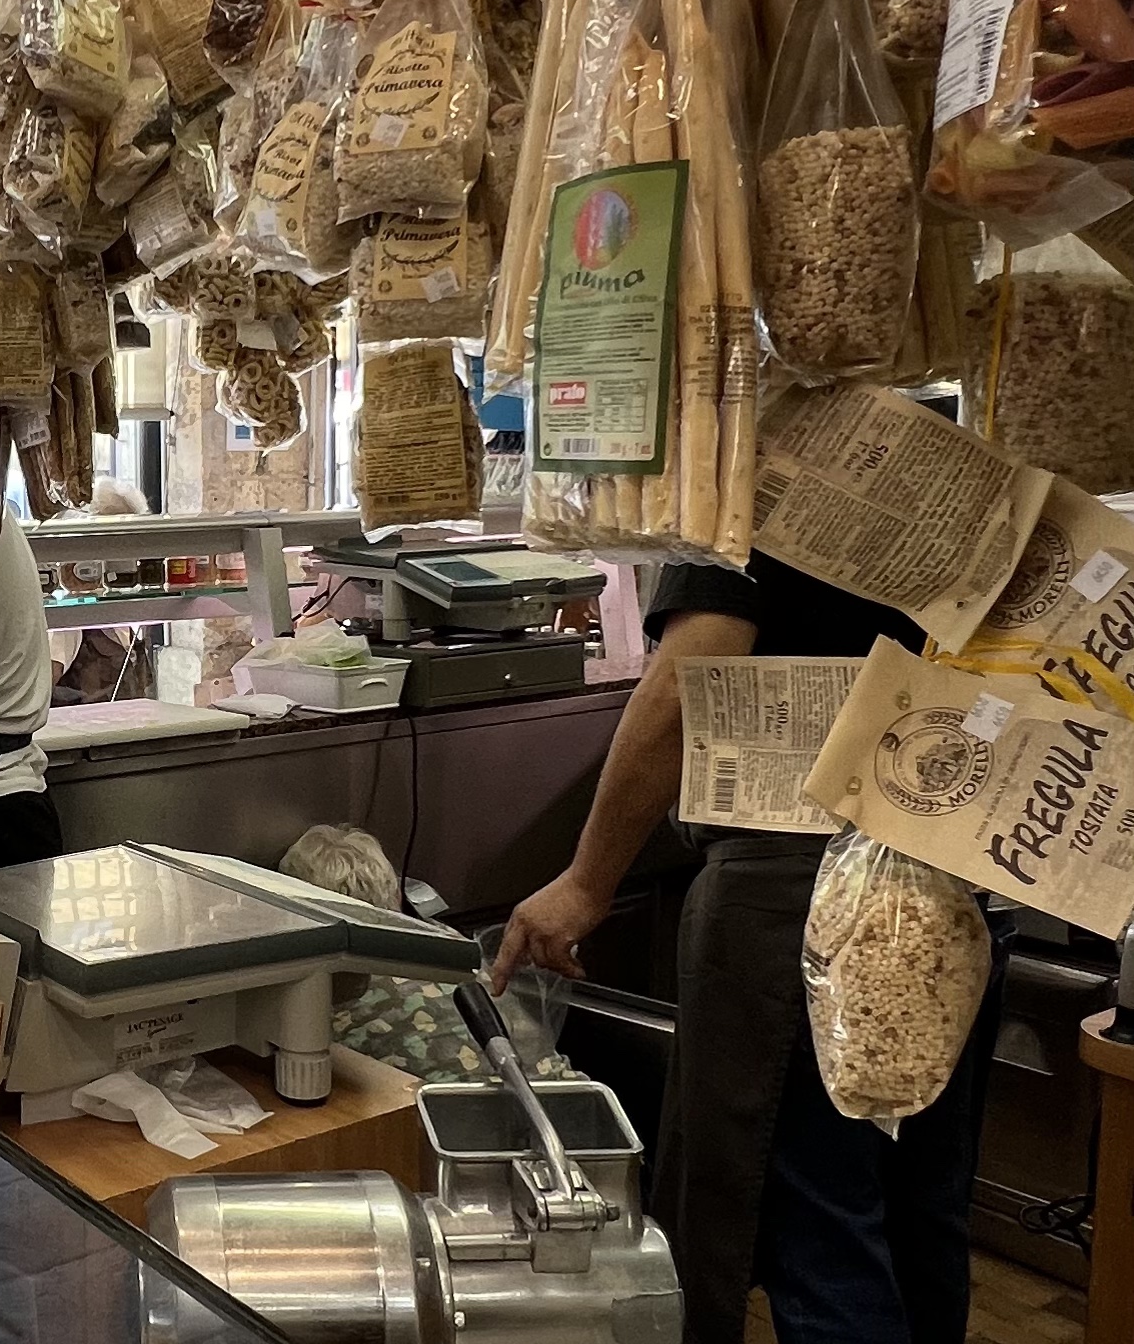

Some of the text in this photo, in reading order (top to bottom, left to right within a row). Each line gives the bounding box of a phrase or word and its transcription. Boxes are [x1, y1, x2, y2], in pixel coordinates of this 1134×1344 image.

[363, 78, 443, 96] Primavera
[380, 224, 461, 243] Primavera
[1018, 559, 1069, 624] MORELLI
[985, 718, 1108, 885] FREGULA
[1069, 784, 1118, 854] TOSTATA
